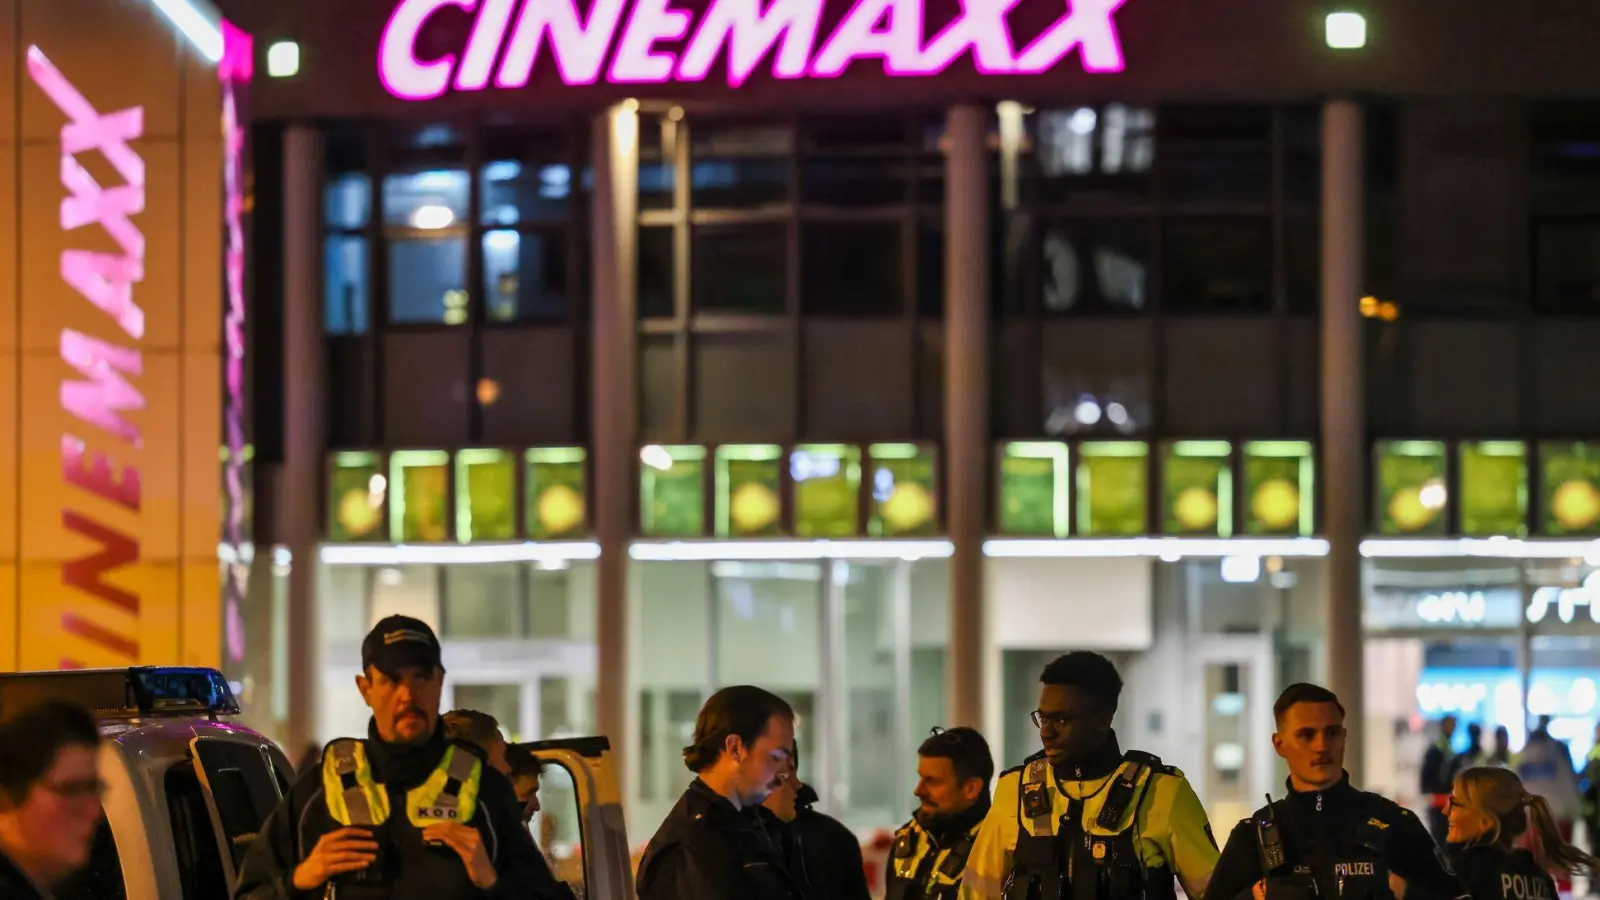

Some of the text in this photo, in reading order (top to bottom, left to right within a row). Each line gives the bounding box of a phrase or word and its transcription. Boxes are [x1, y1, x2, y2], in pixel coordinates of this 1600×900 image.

[377, 0, 1126, 99] CINEMAXX
[26, 43, 146, 669] INEMAXX
[418, 807, 457, 818] KOD
[1334, 862, 1374, 876] POLIZEI
